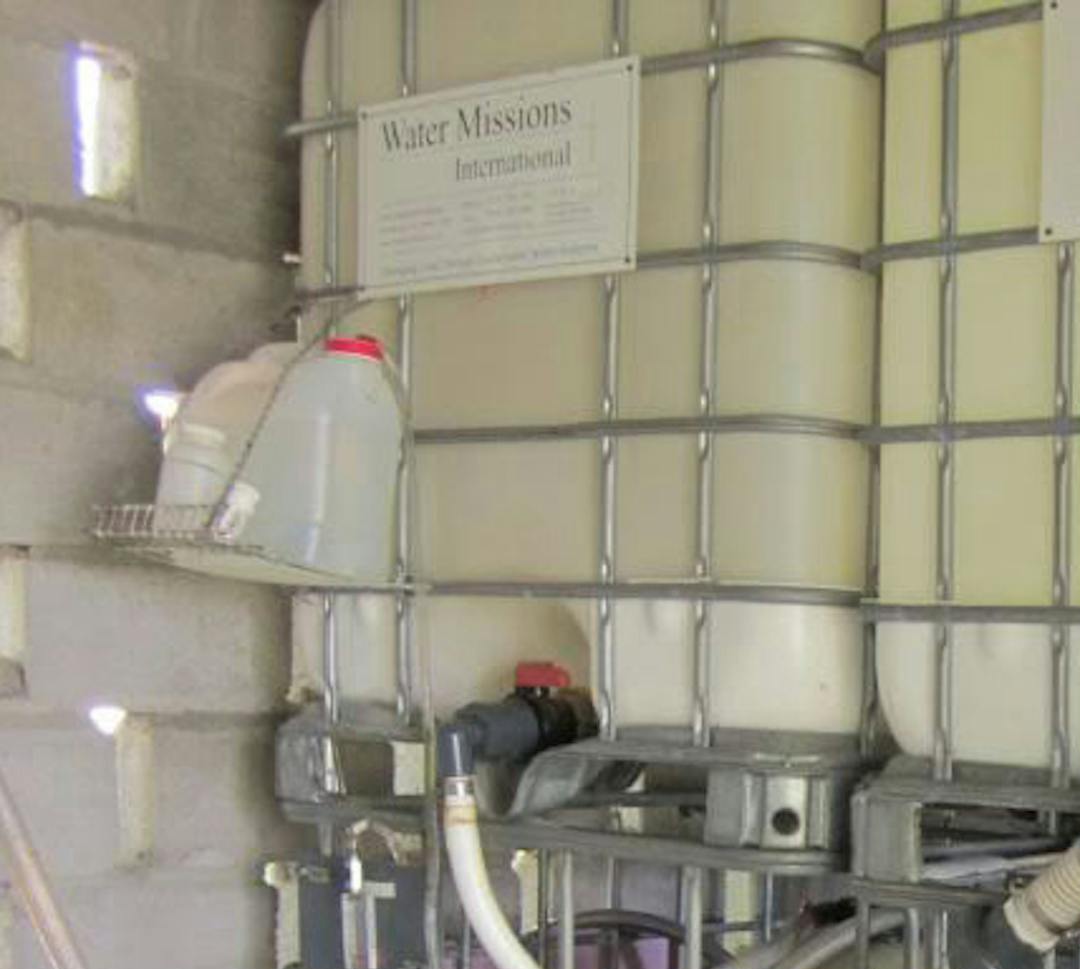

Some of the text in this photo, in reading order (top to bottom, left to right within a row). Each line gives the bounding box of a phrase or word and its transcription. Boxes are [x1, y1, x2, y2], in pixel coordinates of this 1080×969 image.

[381, 97, 572, 152] Water Missions
[456, 141, 571, 182] International
